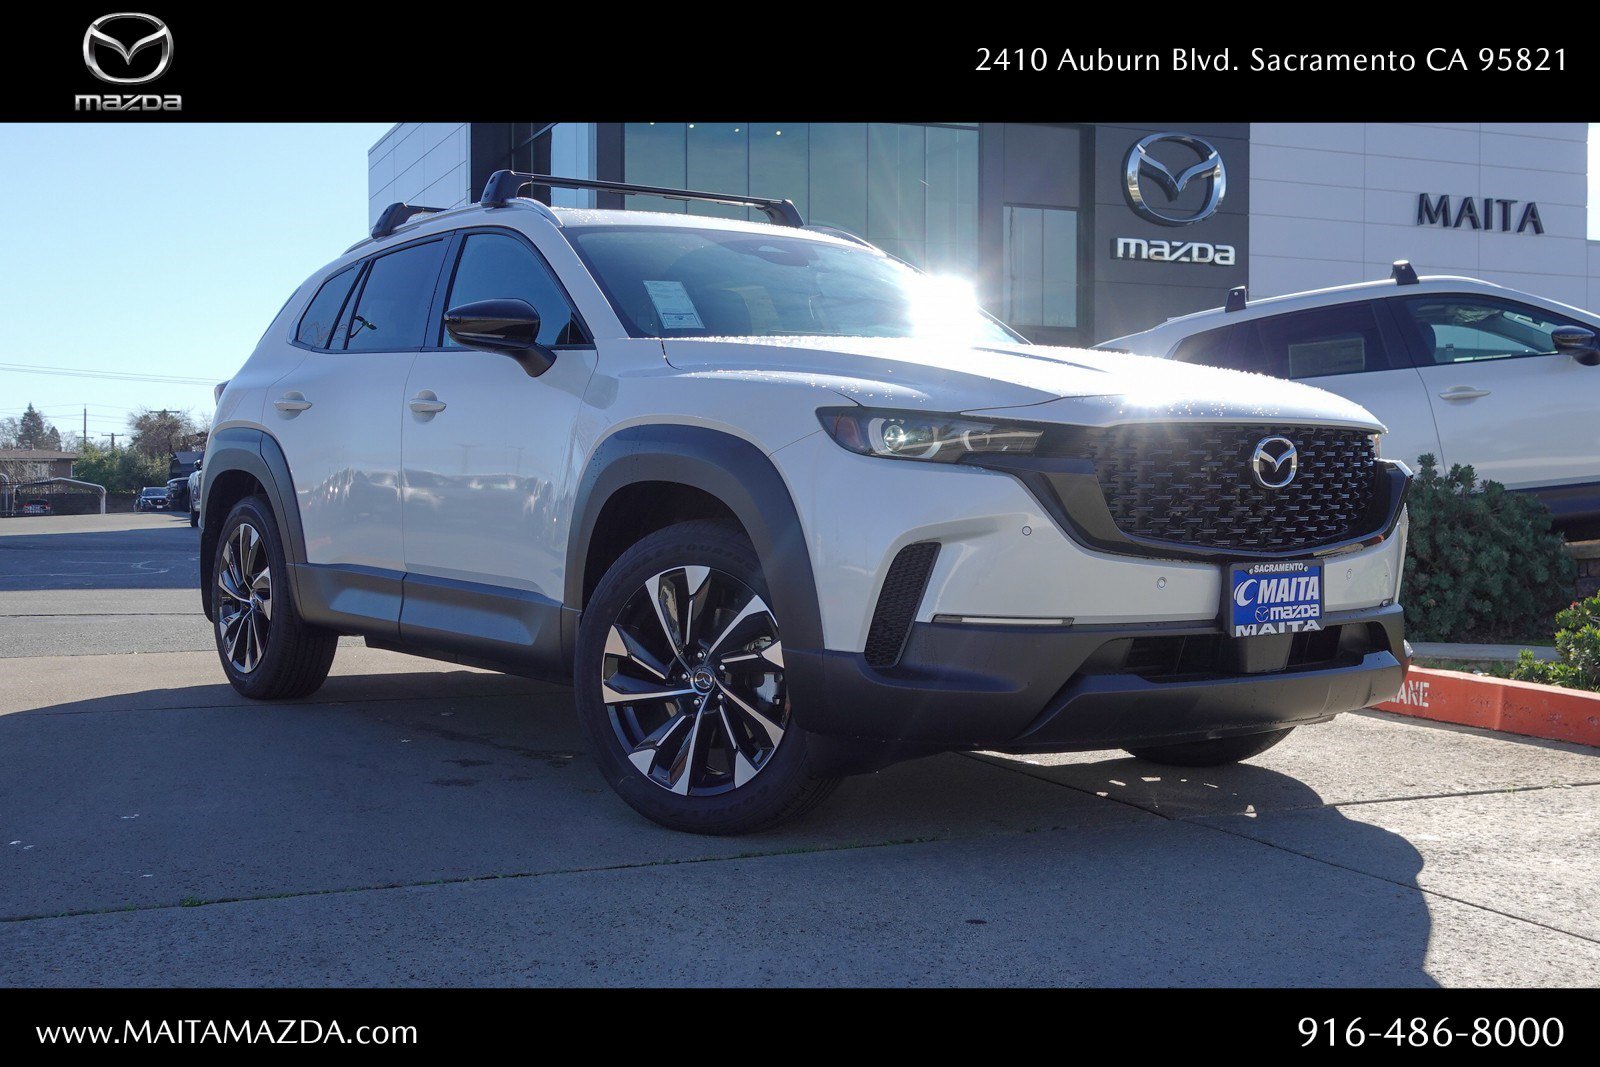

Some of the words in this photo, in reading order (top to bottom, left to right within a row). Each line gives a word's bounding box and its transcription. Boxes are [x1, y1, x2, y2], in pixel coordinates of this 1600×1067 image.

[1416, 192, 1545, 235] MAITA
[1115, 237, 1236, 266] mazda
[1253, 562, 1304, 573] SACRAMENTO
[1257, 575, 1320, 604] MAITA
[1269, 603, 1320, 621] mazda
[1235, 619, 1321, 637] MAITA
[1390, 680, 1430, 708] ANE
